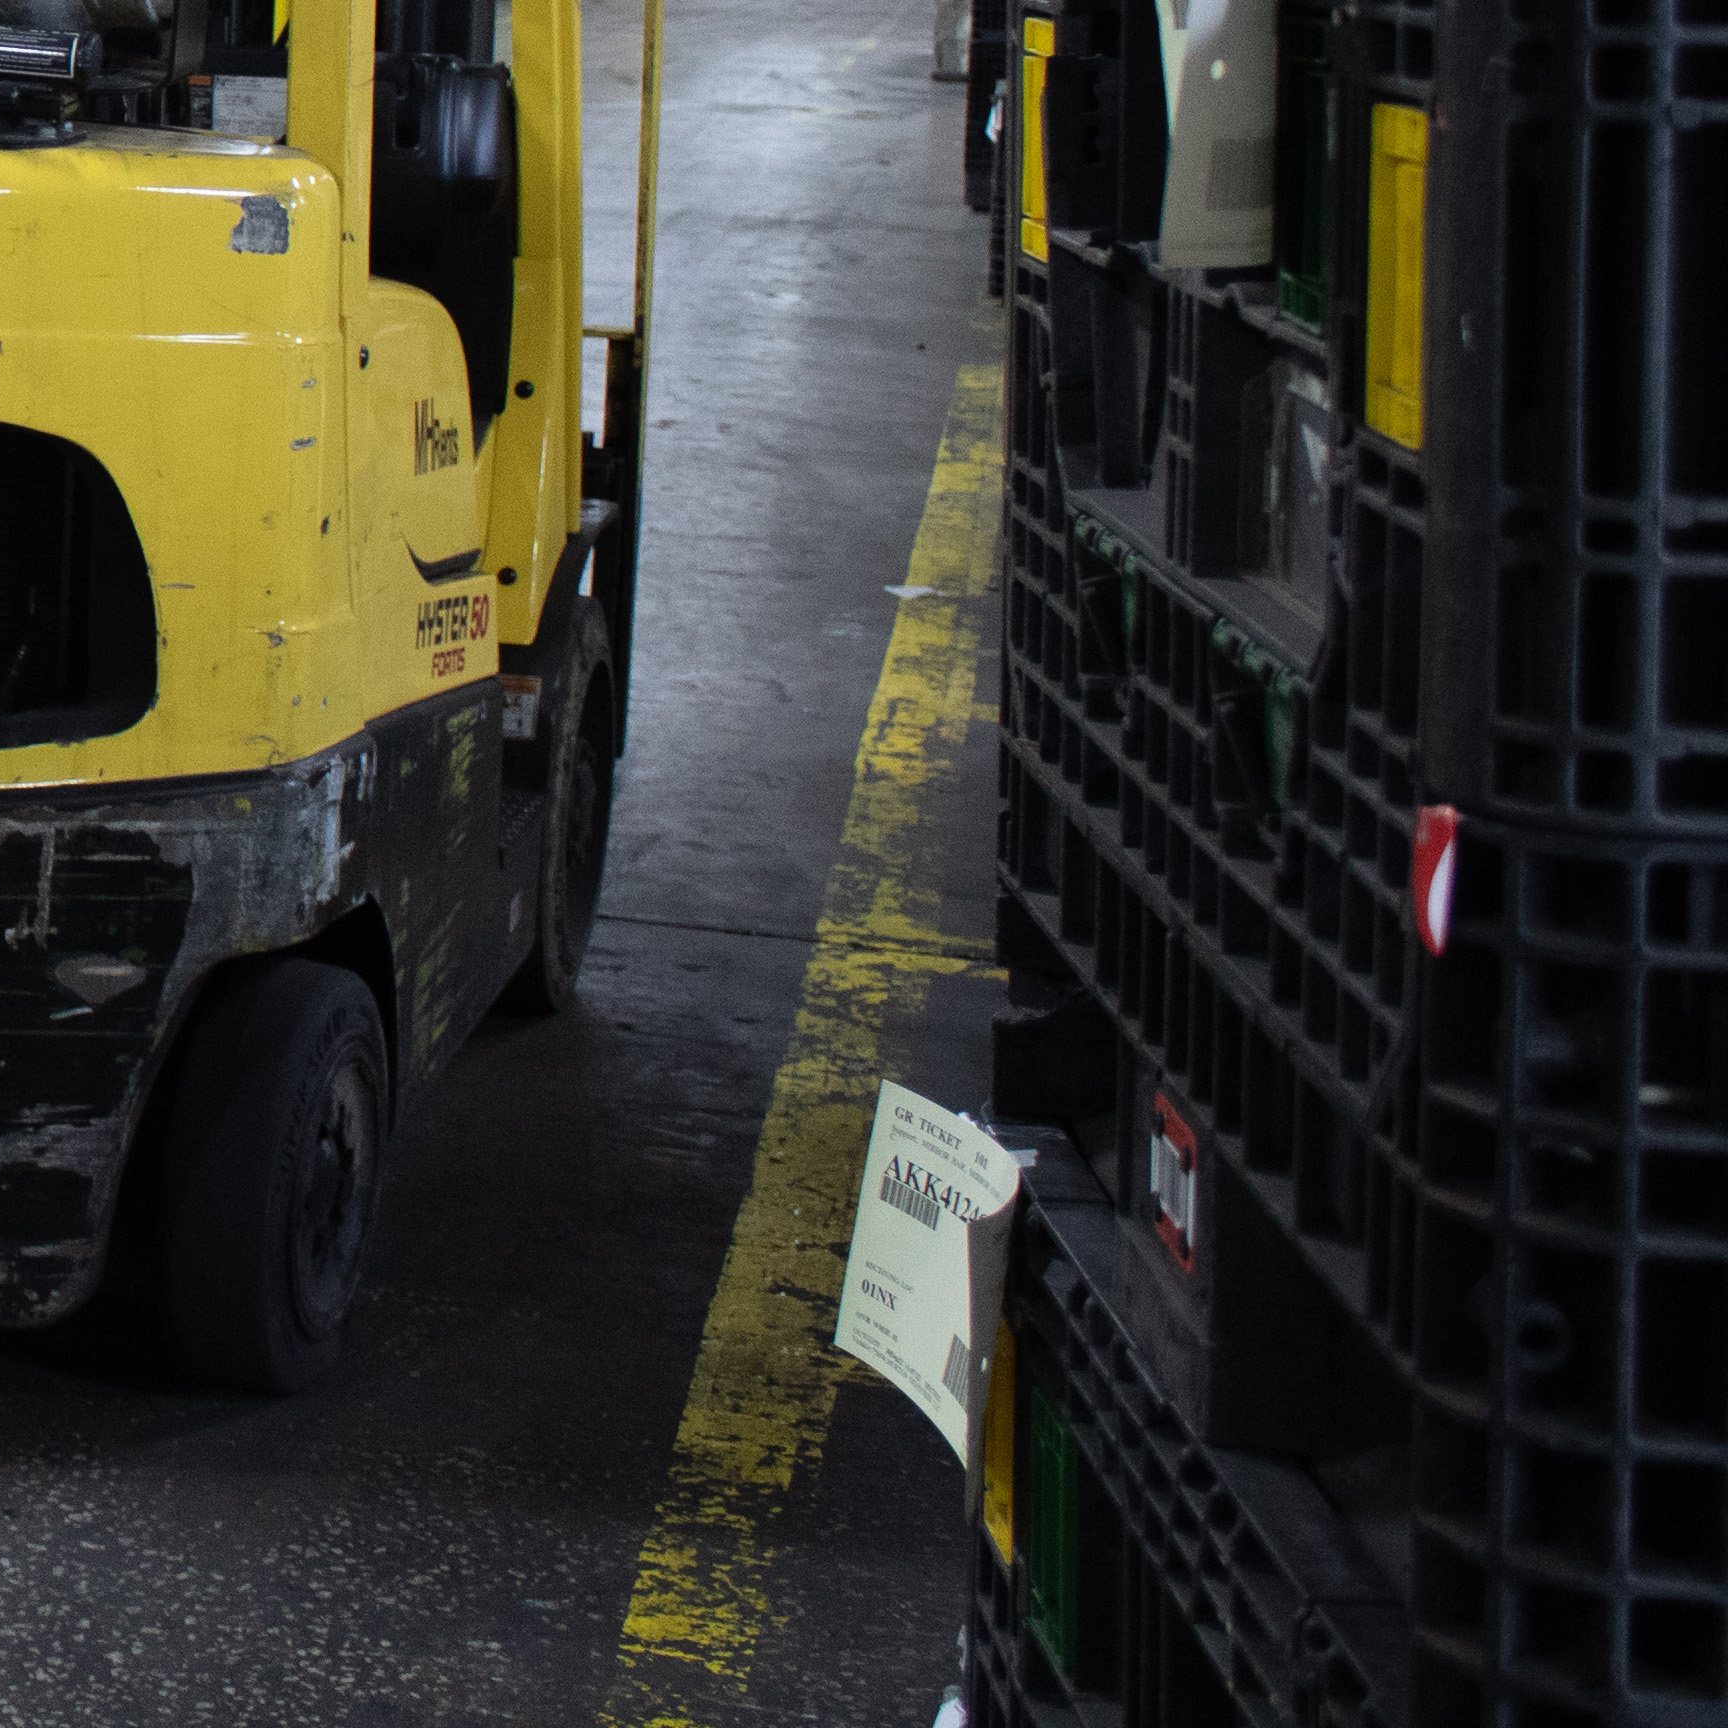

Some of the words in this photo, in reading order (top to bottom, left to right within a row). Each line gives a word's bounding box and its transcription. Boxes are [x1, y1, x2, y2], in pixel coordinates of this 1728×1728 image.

[415, 594, 469, 651] HYSTER
[469, 593, 490, 642] 50
[430, 647, 466, 679] FORTIS
[894, 1106, 914, 1125] GR
[918, 1117, 962, 1151] TICKET
